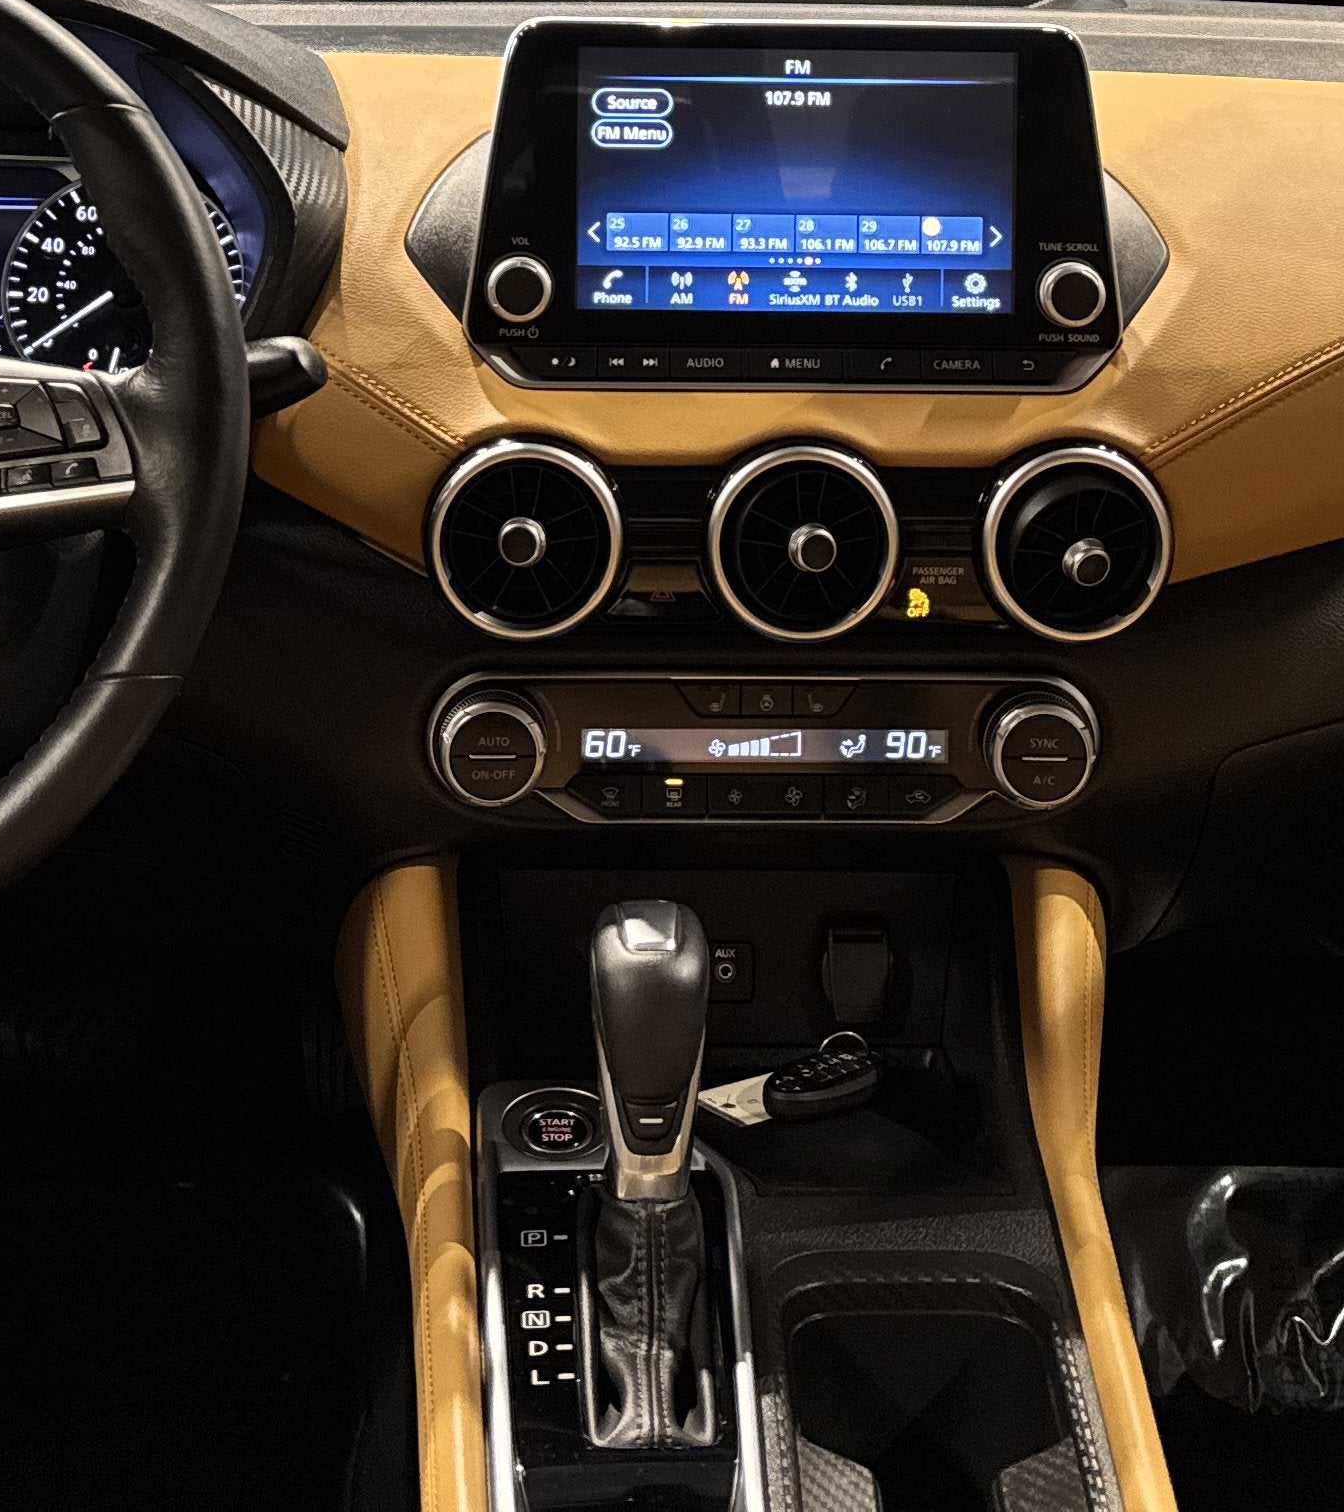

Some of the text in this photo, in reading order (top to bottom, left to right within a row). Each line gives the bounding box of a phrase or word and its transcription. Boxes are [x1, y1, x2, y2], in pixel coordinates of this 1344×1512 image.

[784, 60, 812, 76] FM
[607, 94, 658, 111] Source
[765, 91, 831, 106] 107.9 FM
[597, 126, 667, 141] FM Menu
[75, 206, 98, 222] 60
[610, 218, 626, 230] 25
[672, 218, 689, 230] 26
[735, 218, 752, 231] 27
[798, 220, 815, 232] 28
[861, 220, 878, 232] 29
[40, 237, 65, 254] 40
[512, 237, 530, 246] VOL
[614, 237, 662, 248] 92.5 FM
[678, 237, 725, 249] 92.9 FM
[740, 238, 788, 250] 93.3 FM
[801, 238, 854, 250] 106.1 FM
[864, 240, 917, 251] 106.7 FM
[926, 240, 980, 252] 107.9 FM
[81, 246, 95, 256] 80
[64, 280, 77, 290] 40
[26, 286, 49, 303] 20
[593, 292, 633, 304] Phone
[670, 292, 694, 304] AM
[728, 294, 749, 305] FM
[768, 294, 820, 306] SiriusXM
[824, 294, 879, 306] BT Audio
[892, 296, 923, 307] USB1
[952, 296, 1001, 310] Settings
[498, 328, 525, 338] PUSH
[1038, 334, 1100, 343] PUSH SOUND
[88, 348, 98, 360] 0
[686, 358, 724, 368] AUDIO
[785, 358, 820, 369] MENU
[934, 359, 980, 370] CAMERA
[912, 567, 964, 576] PASSENGER
[920, 576, 957, 584] AIR BAG
[906, 608, 930, 618] OFF
[478, 737, 510, 748] AUTO
[1030, 738, 1059, 749] SYNC
[1032, 776, 1055, 786] A/C
[714, 948, 736, 958] AUX
[538, 1118, 576, 1126] START
[542, 1134, 574, 1142] STOP
[527, 1284, 546, 1299] R
[528, 1340, 548, 1356] D
[531, 1369, 550, 1386] L
